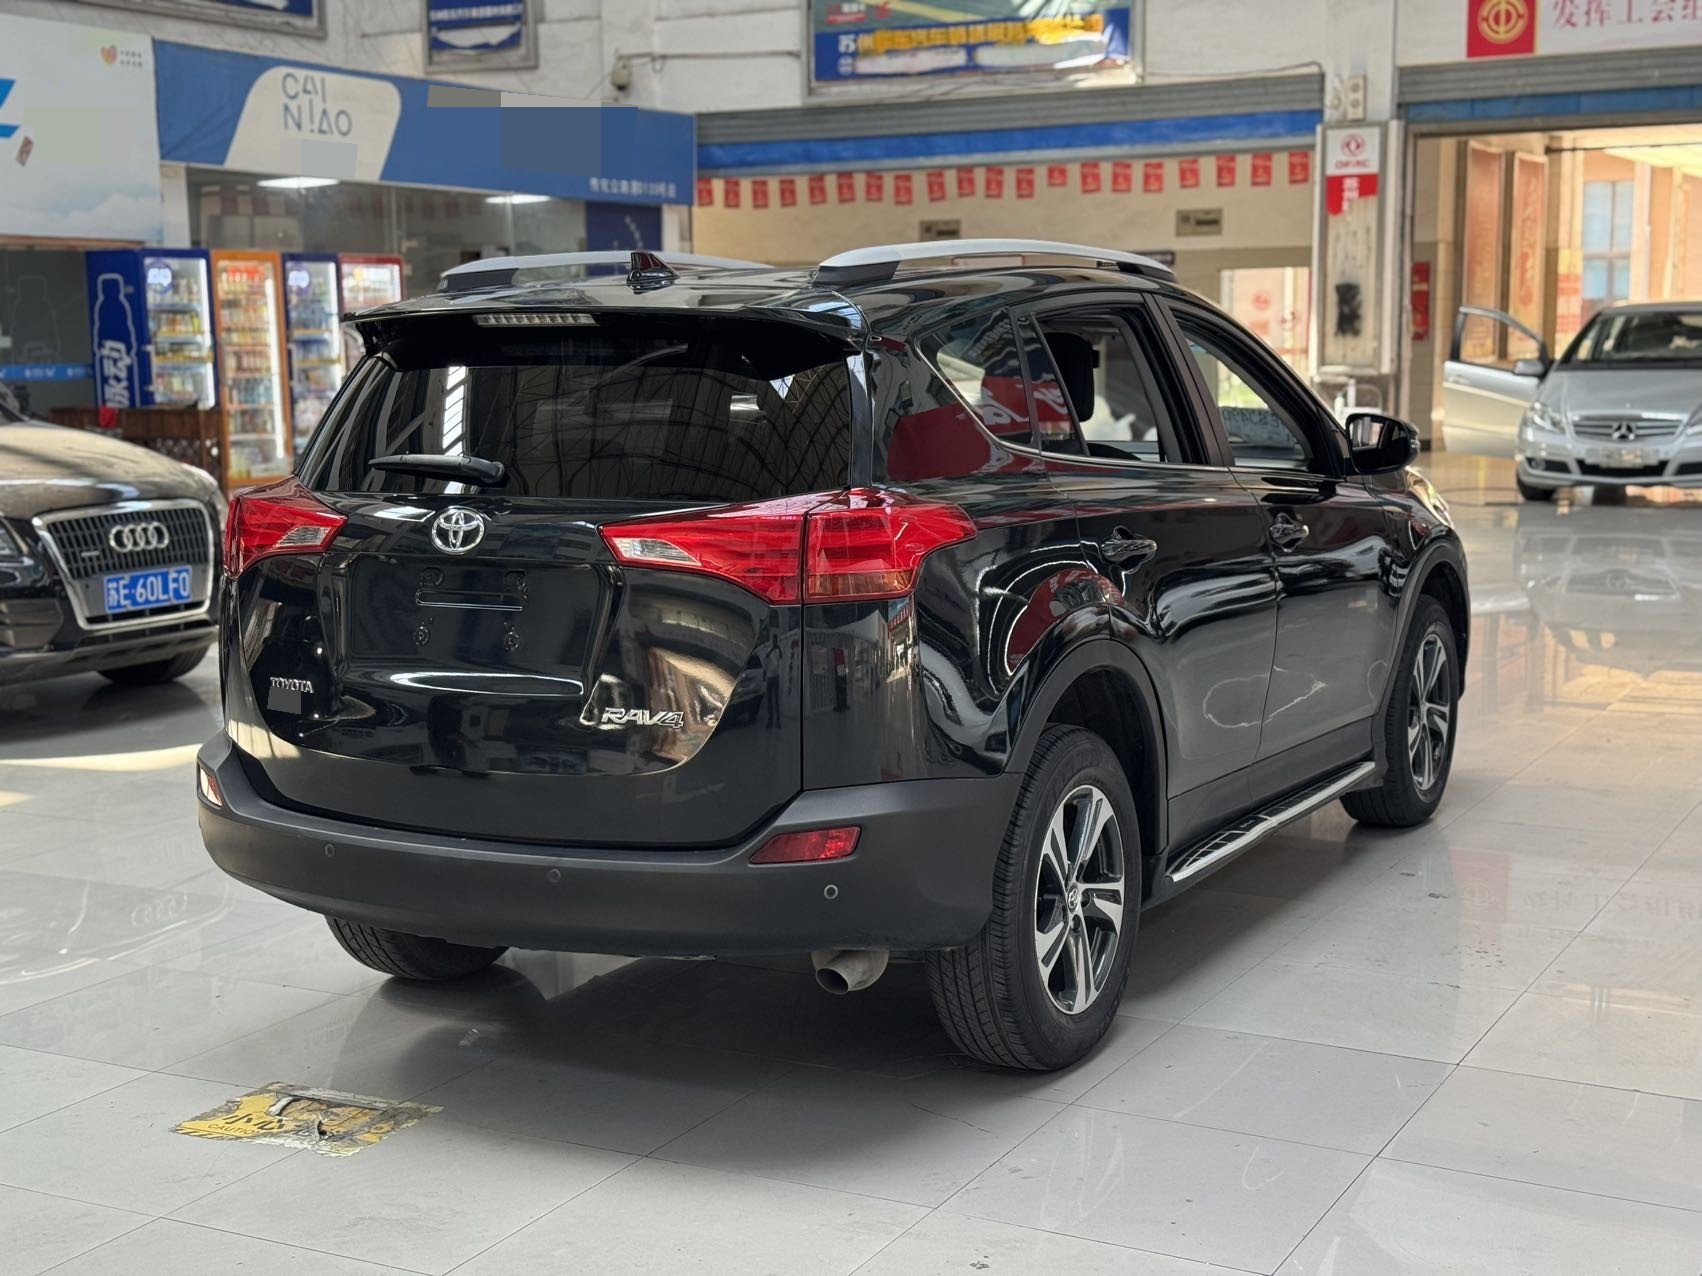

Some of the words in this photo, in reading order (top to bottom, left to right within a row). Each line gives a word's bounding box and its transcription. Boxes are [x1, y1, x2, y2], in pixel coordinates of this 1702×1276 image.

[281, 72, 327, 104] CAI
[270, 676, 315, 694] TOYOTA
[601, 707, 685, 729] RAV4
